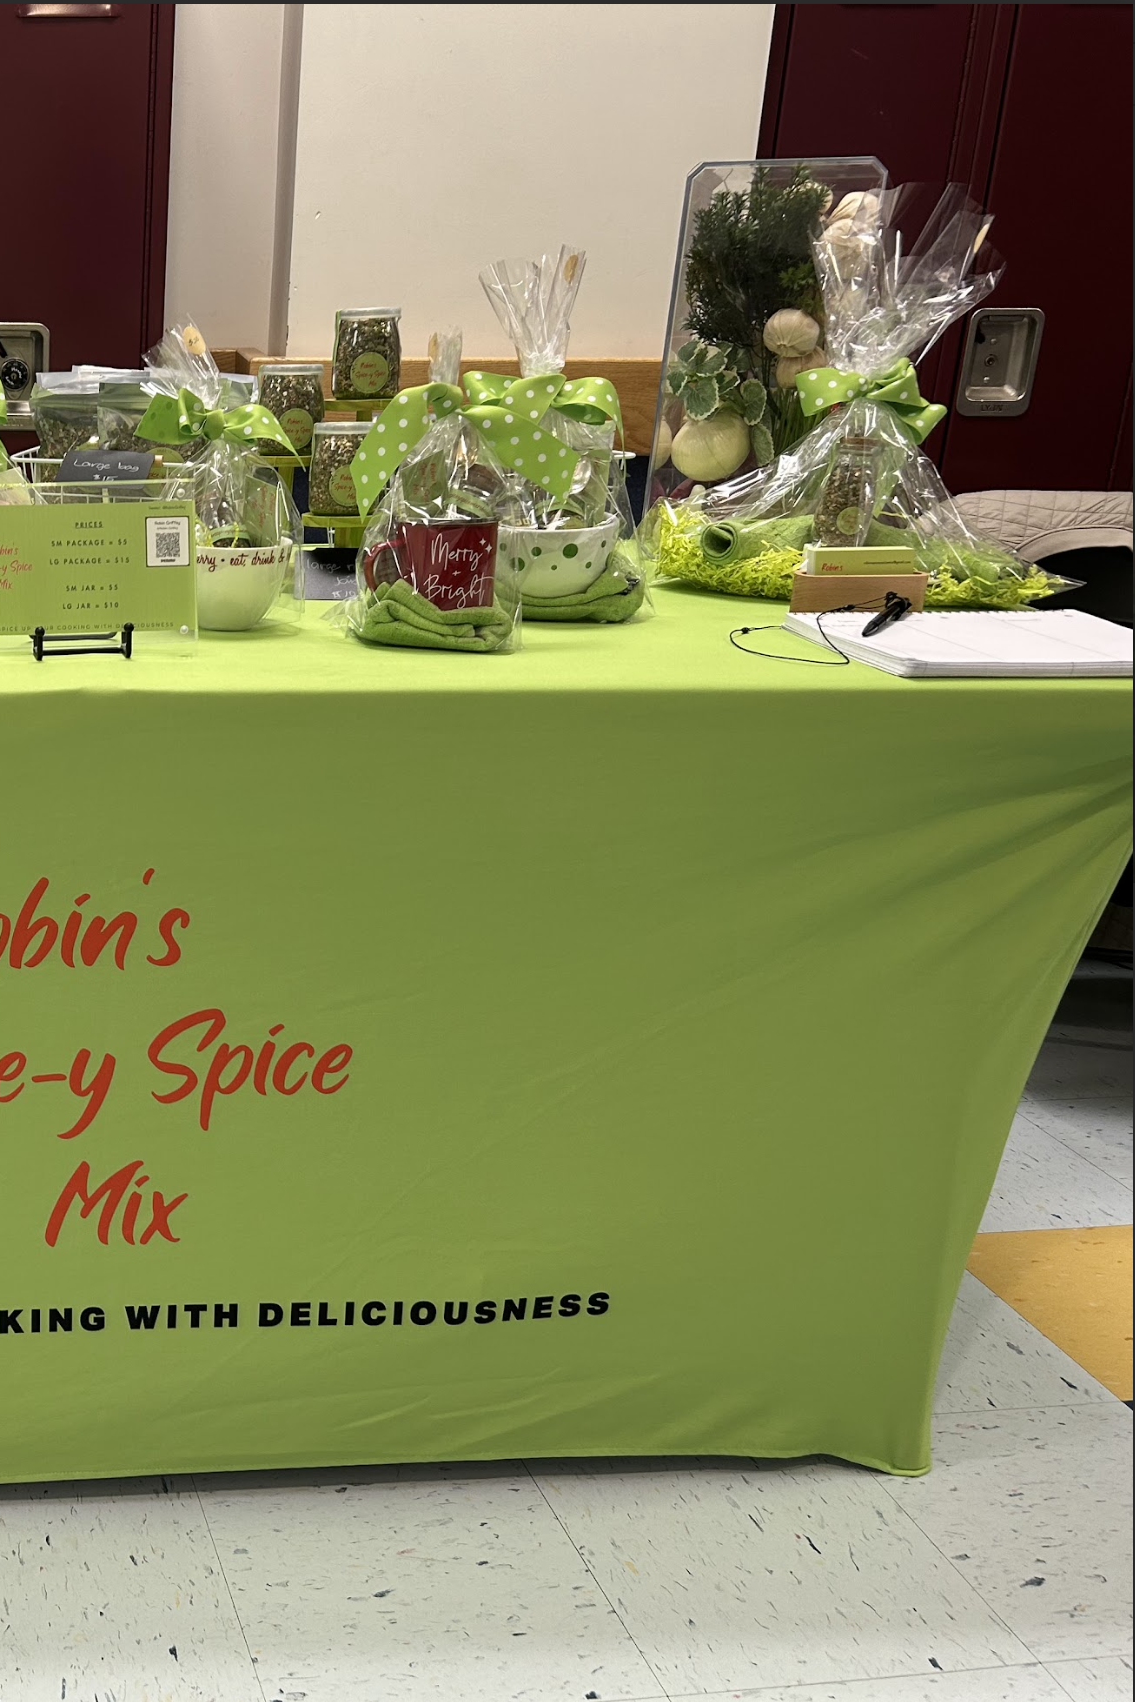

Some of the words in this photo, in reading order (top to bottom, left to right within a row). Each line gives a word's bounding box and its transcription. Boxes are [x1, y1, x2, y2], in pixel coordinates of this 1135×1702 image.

[73, 459, 111, 471] Large
[118, 462, 140, 472] bag
[75, 521, 104, 529] PRICES
[118, 538, 128, 546] $5
[251, 550, 275, 565] drink
[431, 533, 483, 571] Merry
[10, 559, 33, 575] Spice
[49, 558, 60, 566] LG
[63, 557, 102, 565] PACKAGE
[115, 556, 130, 564] $15
[66, 584, 78, 592] SM
[109, 583, 119, 591] $5
[423, 572, 494, 609] Bright
[62, 602, 72, 610] LG
[76, 602, 91, 610] JAR
[104, 601, 119, 609] $10
[148, 1008, 353, 1131] Spice
[45, 1160, 189, 1247] Mix
[125, 1303, 239, 1330] WITH
[258, 1291, 611, 1328] DELICIOUSNESS
